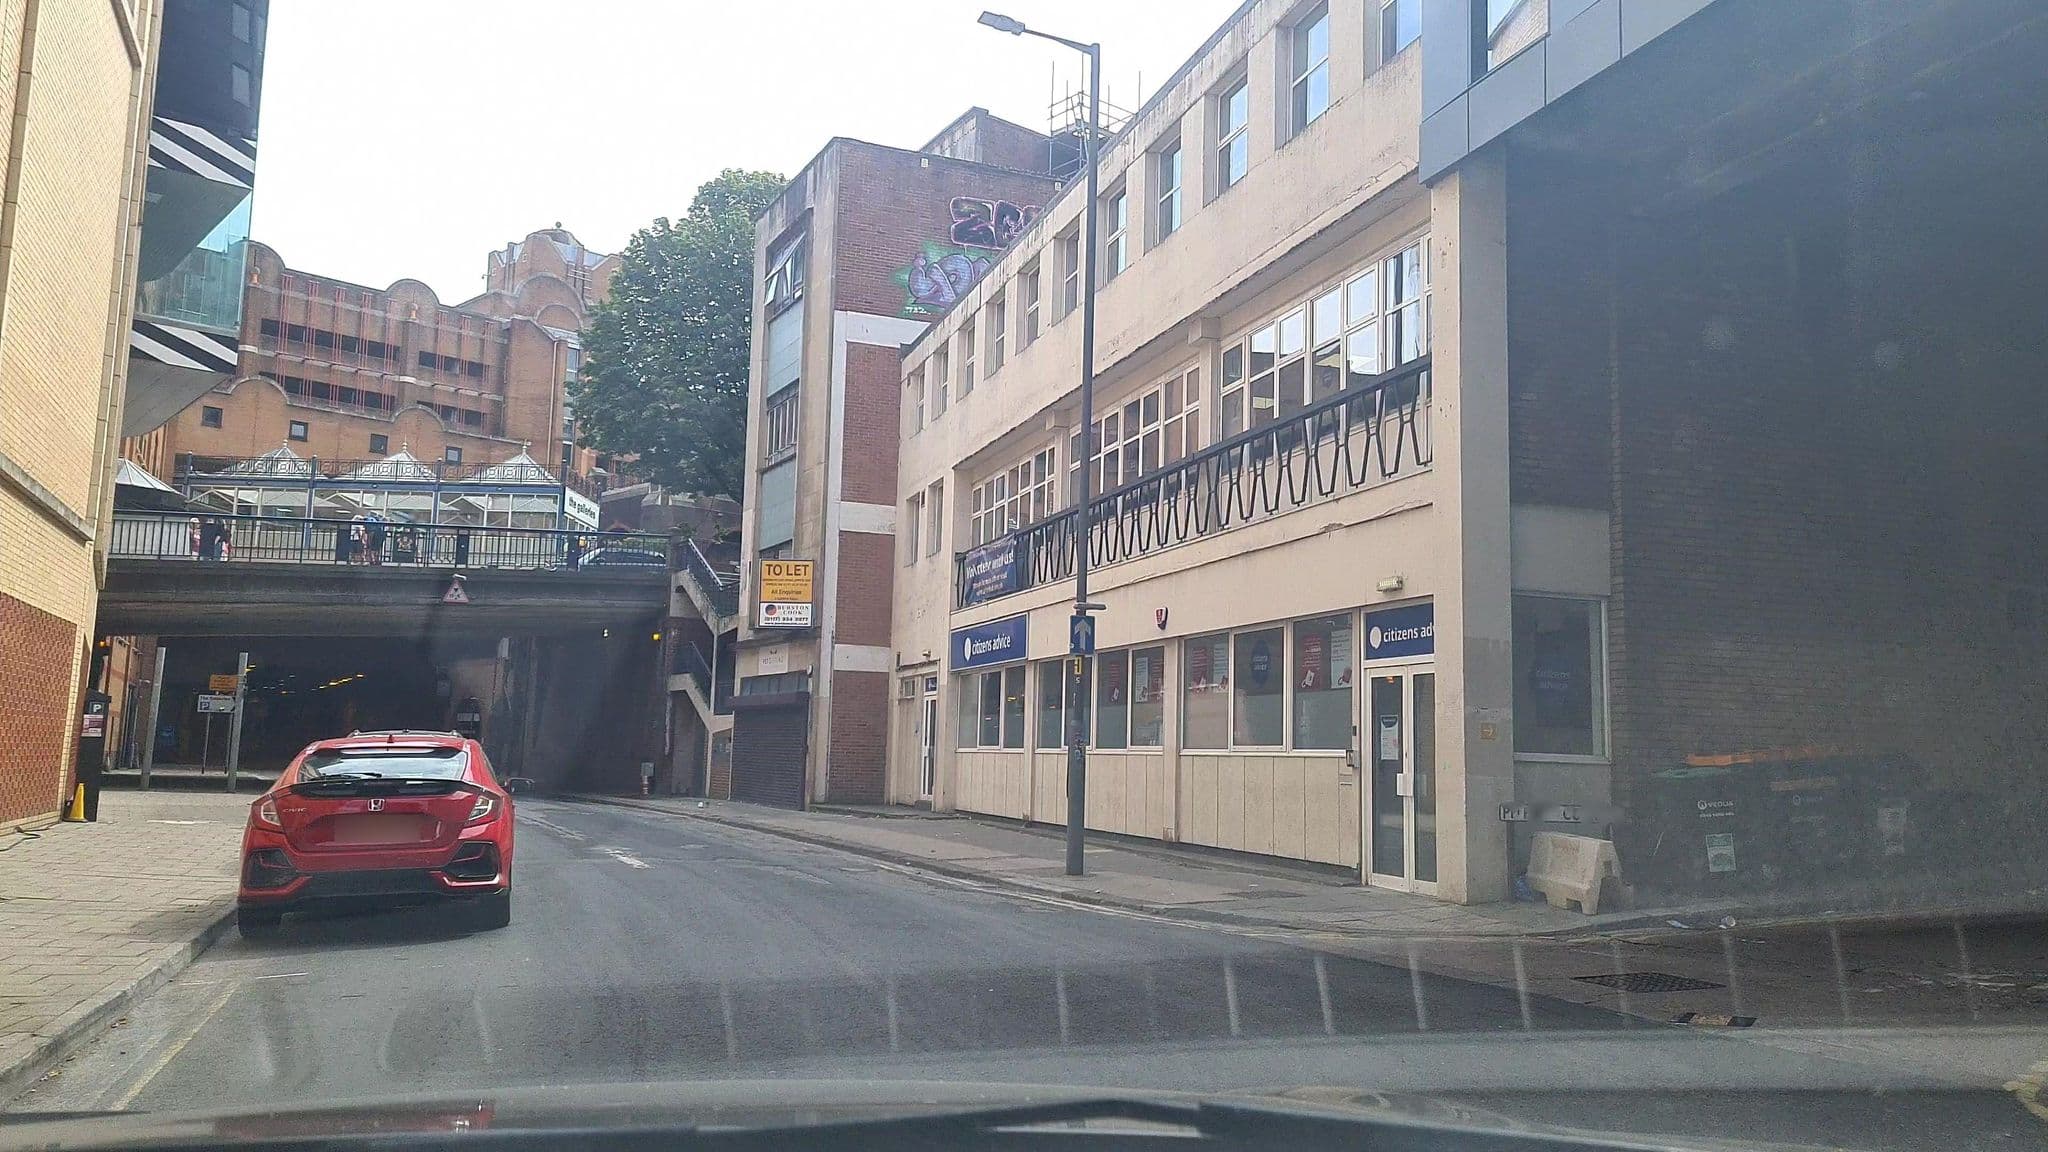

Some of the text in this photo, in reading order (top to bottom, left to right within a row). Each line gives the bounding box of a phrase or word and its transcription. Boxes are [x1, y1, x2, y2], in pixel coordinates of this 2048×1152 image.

[765, 563, 810, 577] TO LET
[1383, 621, 1434, 643] citizens ad
[971, 633, 1012, 656] citizens advice
[93, 704, 102, 713] P
